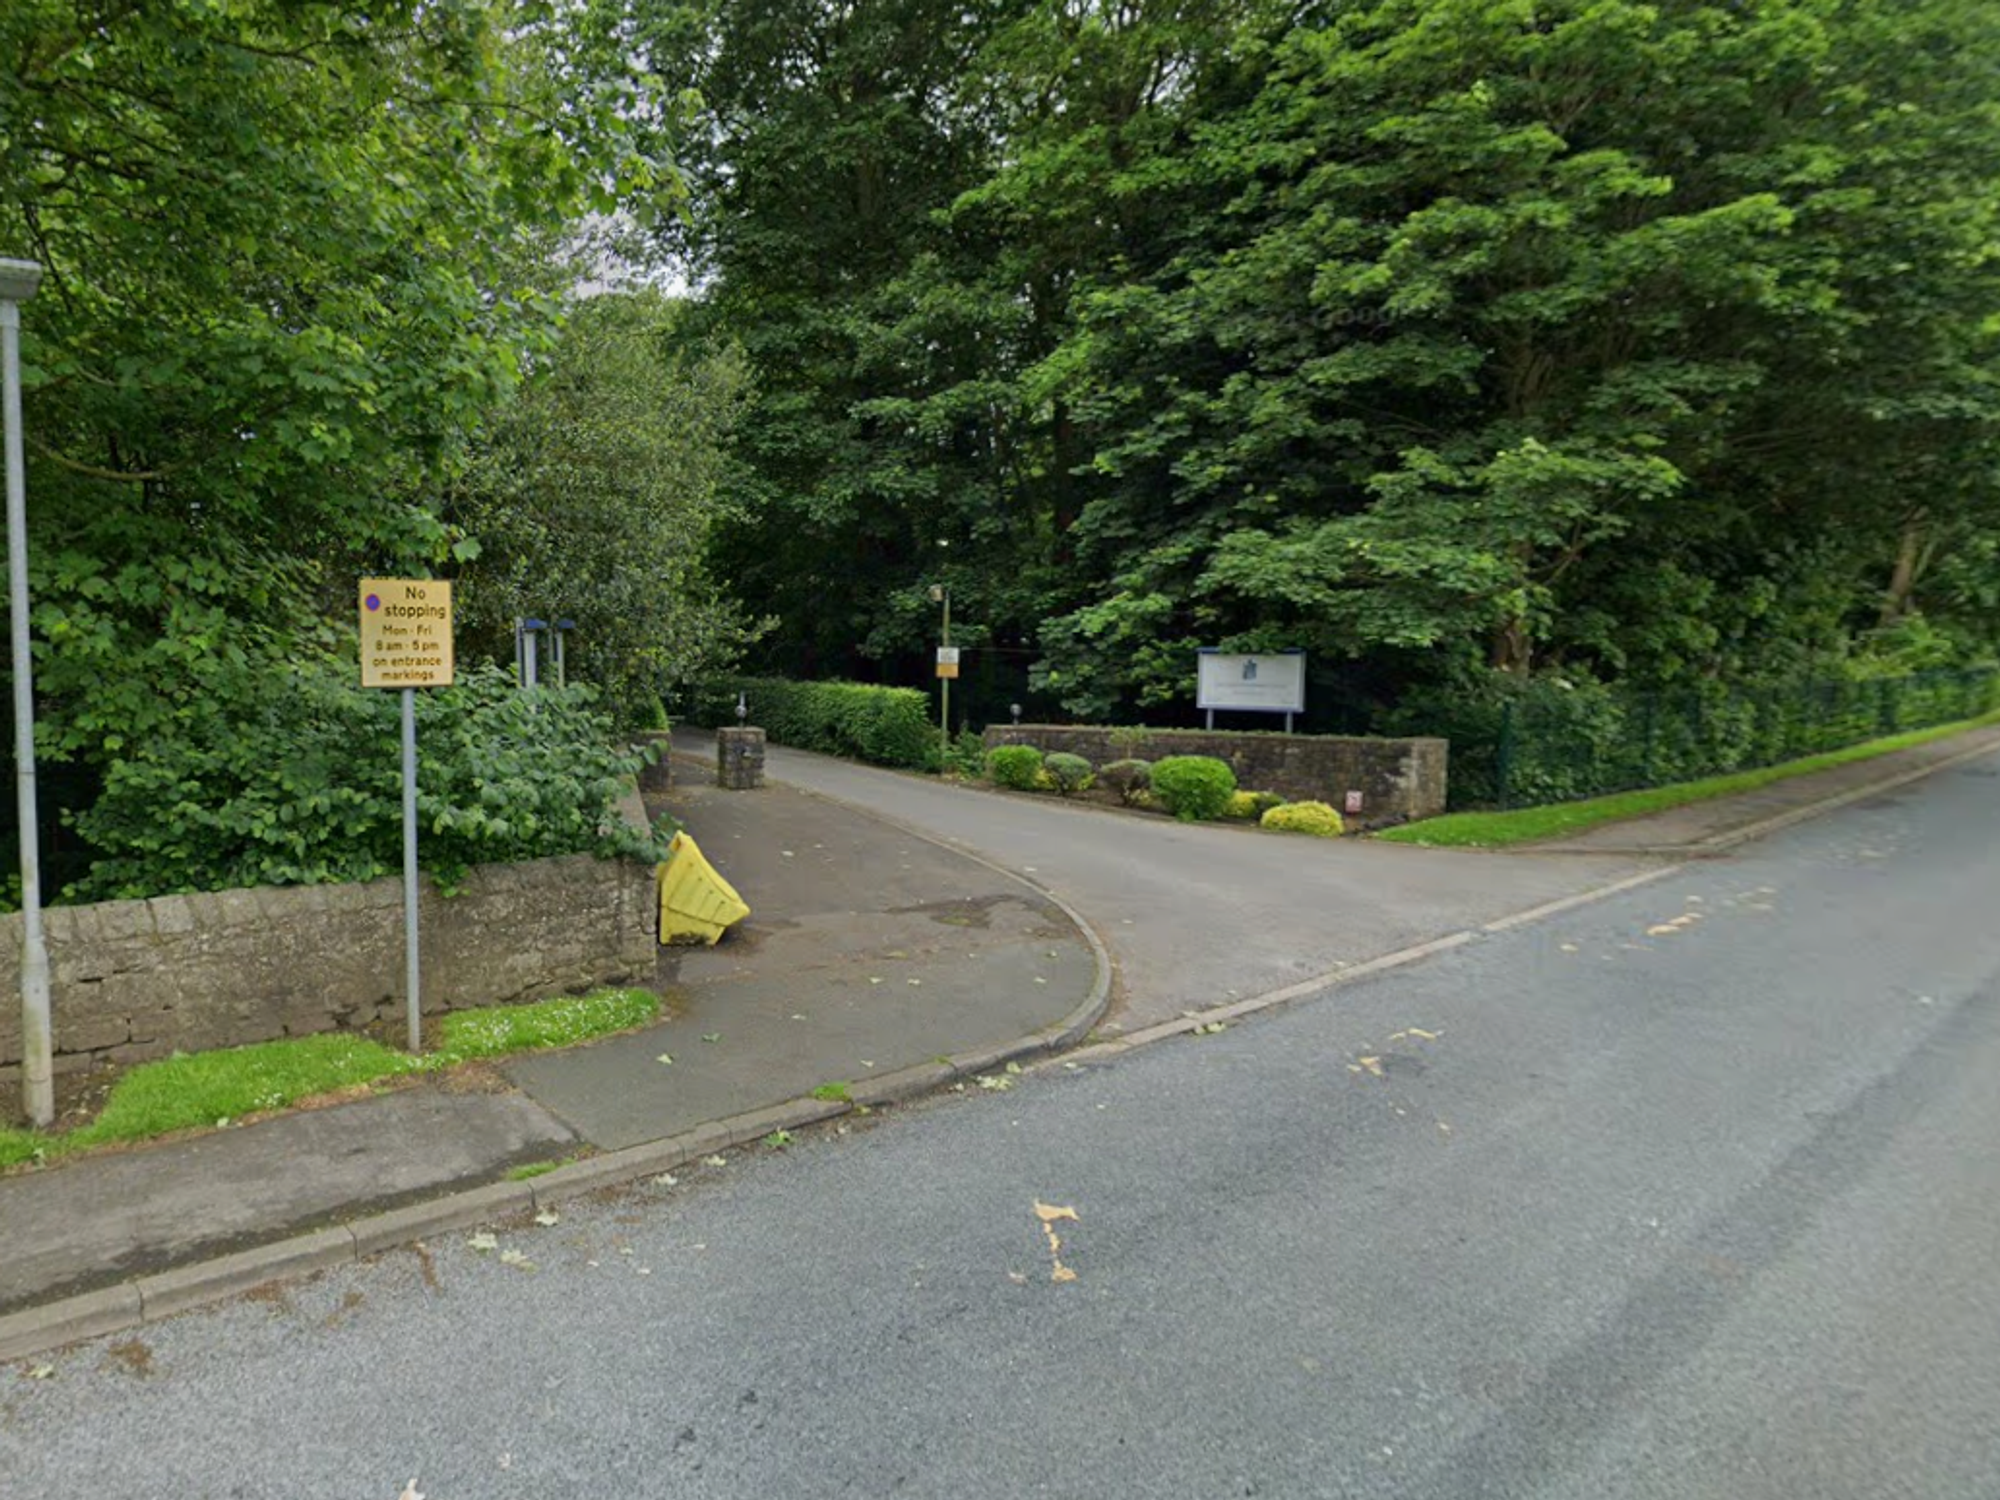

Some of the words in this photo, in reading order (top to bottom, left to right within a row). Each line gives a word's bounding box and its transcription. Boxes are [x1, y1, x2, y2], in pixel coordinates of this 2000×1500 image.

[405, 586, 426, 600] No
[384, 603, 446, 619] stopping
[382, 625, 408, 635] Mon
[416, 625, 432, 635] Fri
[375, 640, 383, 651] 8
[386, 641, 402, 651] am
[412, 640, 419, 651] 5
[422, 641, 439, 652] pm
[372, 657, 388, 667] on
[391, 656, 442, 666] entrance
[381, 669, 434, 681] markings
